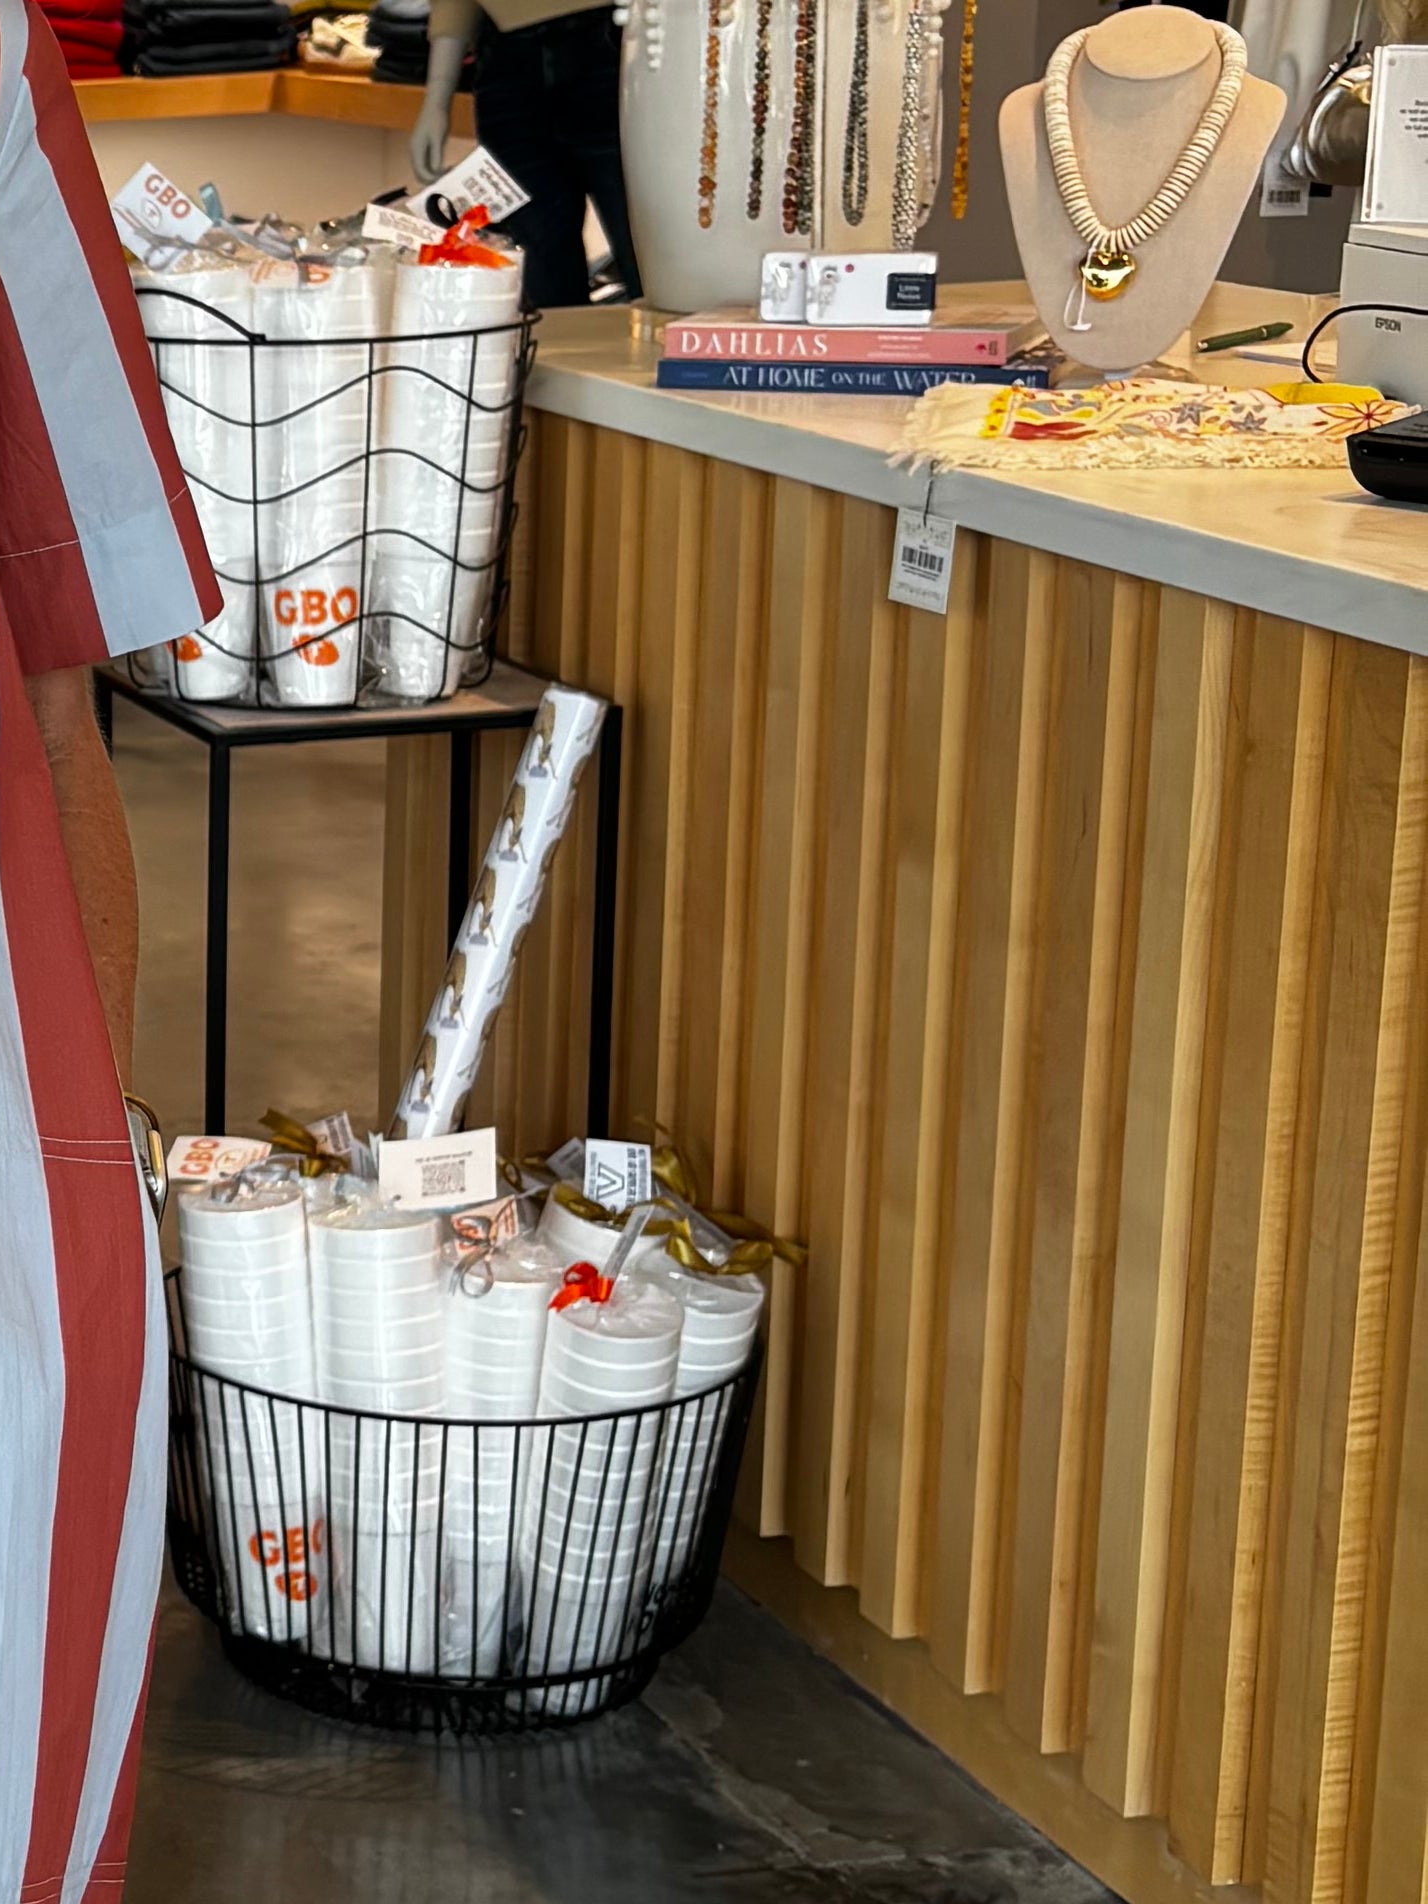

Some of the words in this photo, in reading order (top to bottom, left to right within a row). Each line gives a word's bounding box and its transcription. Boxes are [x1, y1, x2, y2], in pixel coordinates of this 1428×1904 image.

[144, 174, 191, 219] GBO
[1375, 317, 1401, 333] EPSON
[681, 331, 828, 356] DAHLIAS
[722, 366, 753, 386] AT
[757, 367, 825, 388] HOME
[831, 371, 853, 386] ON
[855, 371, 887, 387] THE
[274, 586, 358, 626] GBO
[179, 1138, 221, 1175] GBO
